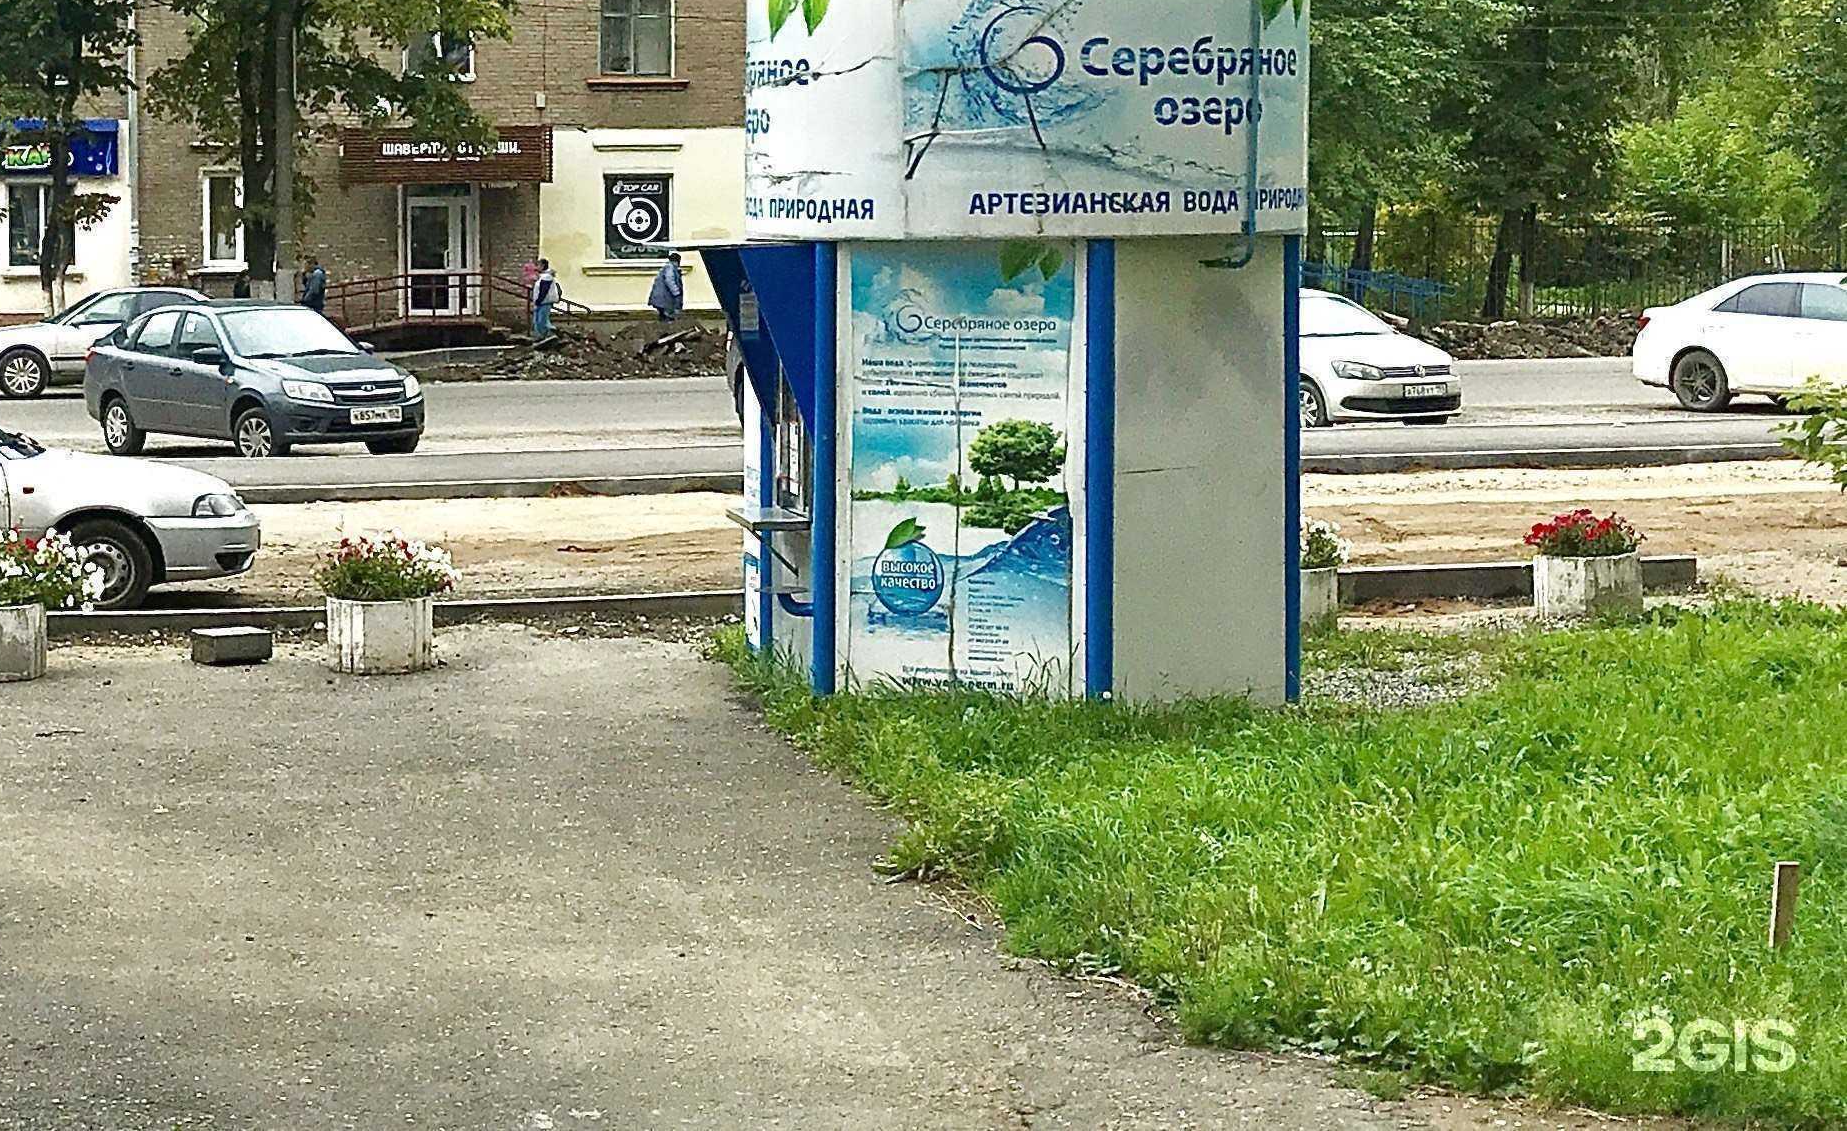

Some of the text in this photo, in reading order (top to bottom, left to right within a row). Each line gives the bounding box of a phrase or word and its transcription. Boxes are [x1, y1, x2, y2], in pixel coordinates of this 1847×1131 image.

[1080, 36, 1297, 85] Серебряное
[1155, 97, 1262, 134] озеро
[623, 183, 659, 192] TOP CAR
[769, 198, 874, 224] ПРИРОДНАЯ
[969, 191, 1170, 215] АРТЕЗИАНСКАЯ
[1183, 190, 1239, 214] ВОДА
[925, 316, 1057, 333] Серебряное озеро
[882, 562, 935, 573] высокое
[880, 576, 936, 590] качество
